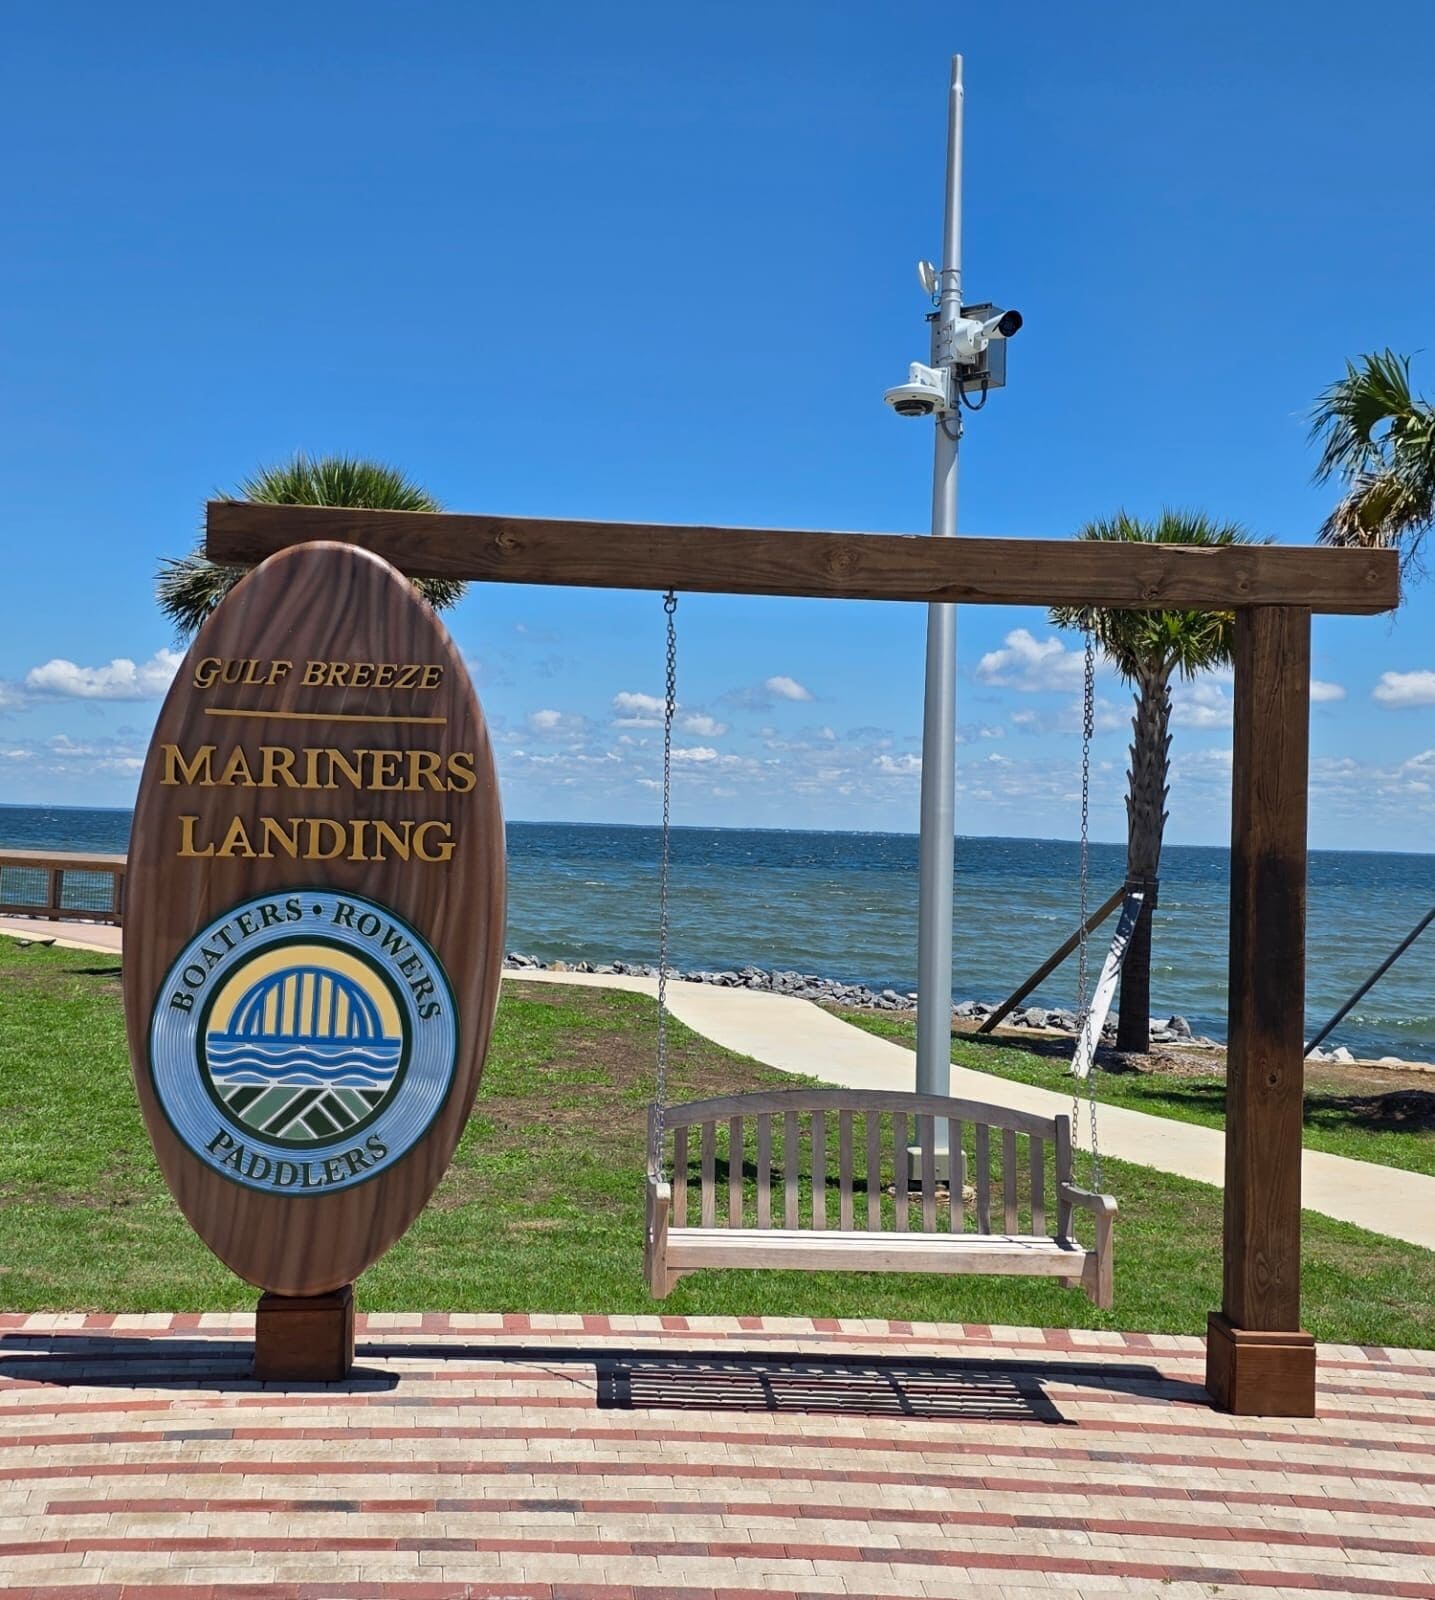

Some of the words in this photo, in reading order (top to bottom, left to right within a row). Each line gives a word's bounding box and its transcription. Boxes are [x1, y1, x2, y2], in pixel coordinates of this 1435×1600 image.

[193, 657, 292, 689] GULF
[301, 660, 444, 690] BREEZE
[160, 743, 477, 793] MARINERS
[176, 815, 456, 862] LANDING
[169, 897, 303, 1015] BOATERS
[330, 900, 442, 1021] ROWERS
[204, 1127, 389, 1188] PADDLERS
